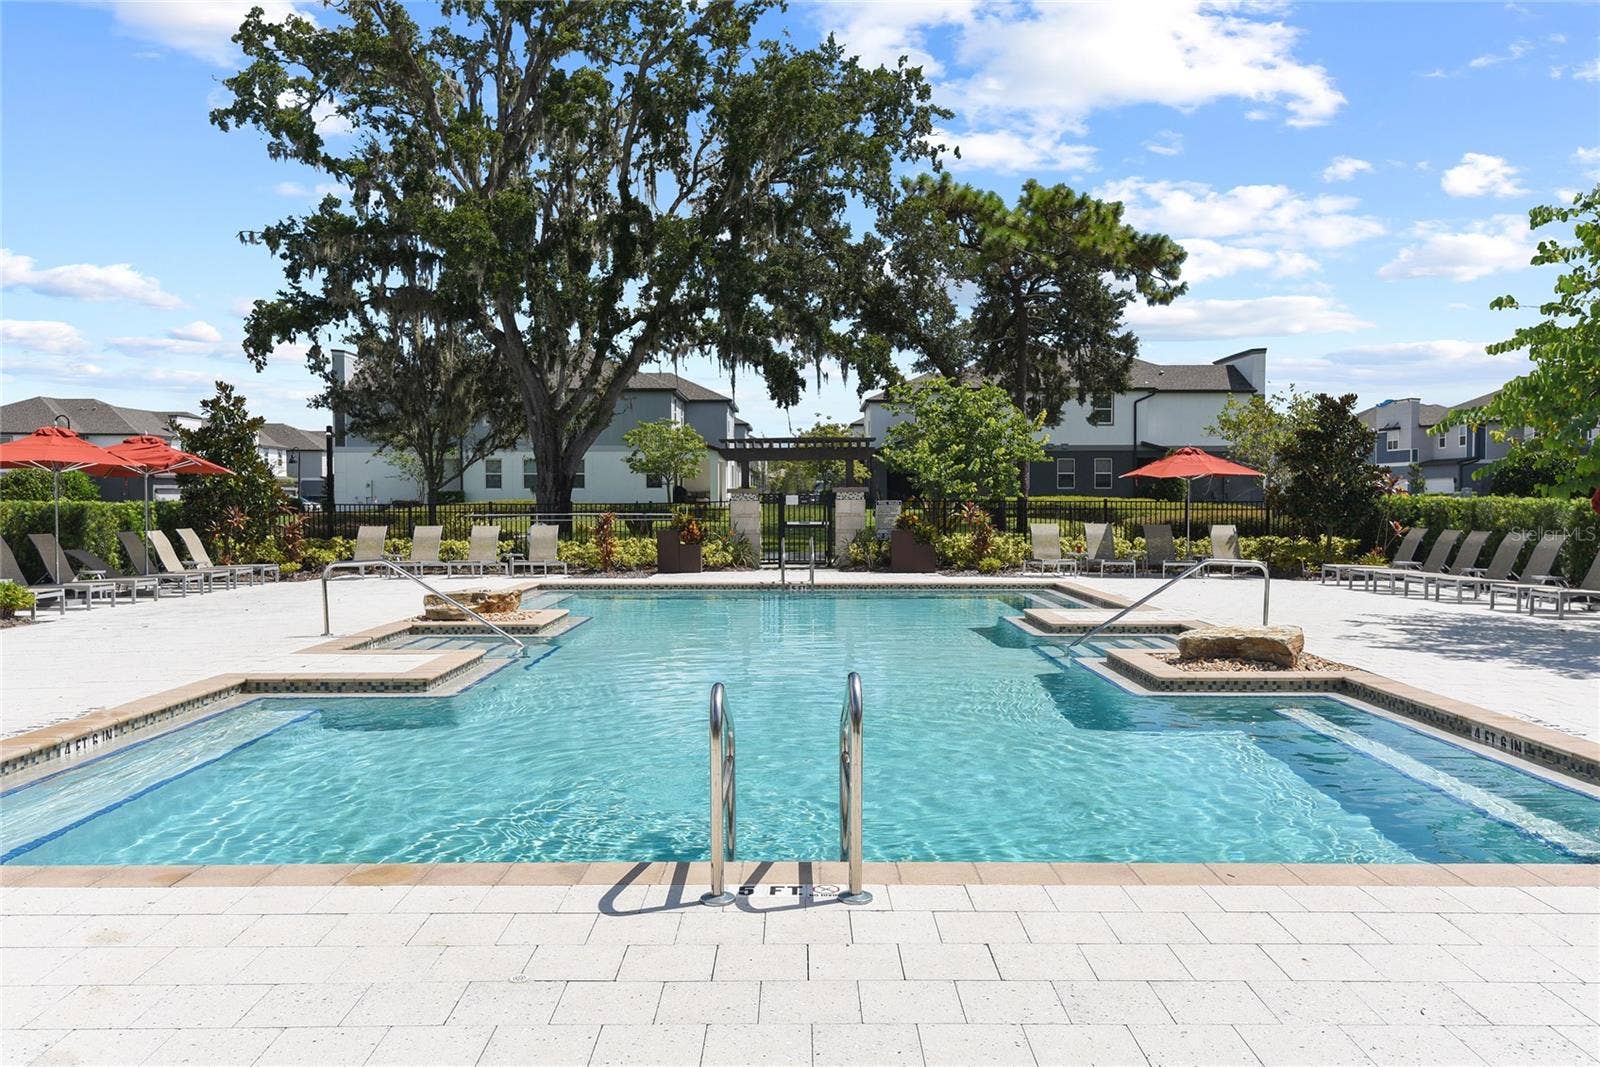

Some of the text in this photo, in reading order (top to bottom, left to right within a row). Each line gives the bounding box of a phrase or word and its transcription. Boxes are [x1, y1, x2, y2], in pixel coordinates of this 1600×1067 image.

[65, 742, 71, 754] 4
[76, 736, 88, 751] FT
[1474, 727, 1522, 752] 4 FT 6 IN
[738, 885, 755, 896] 5
